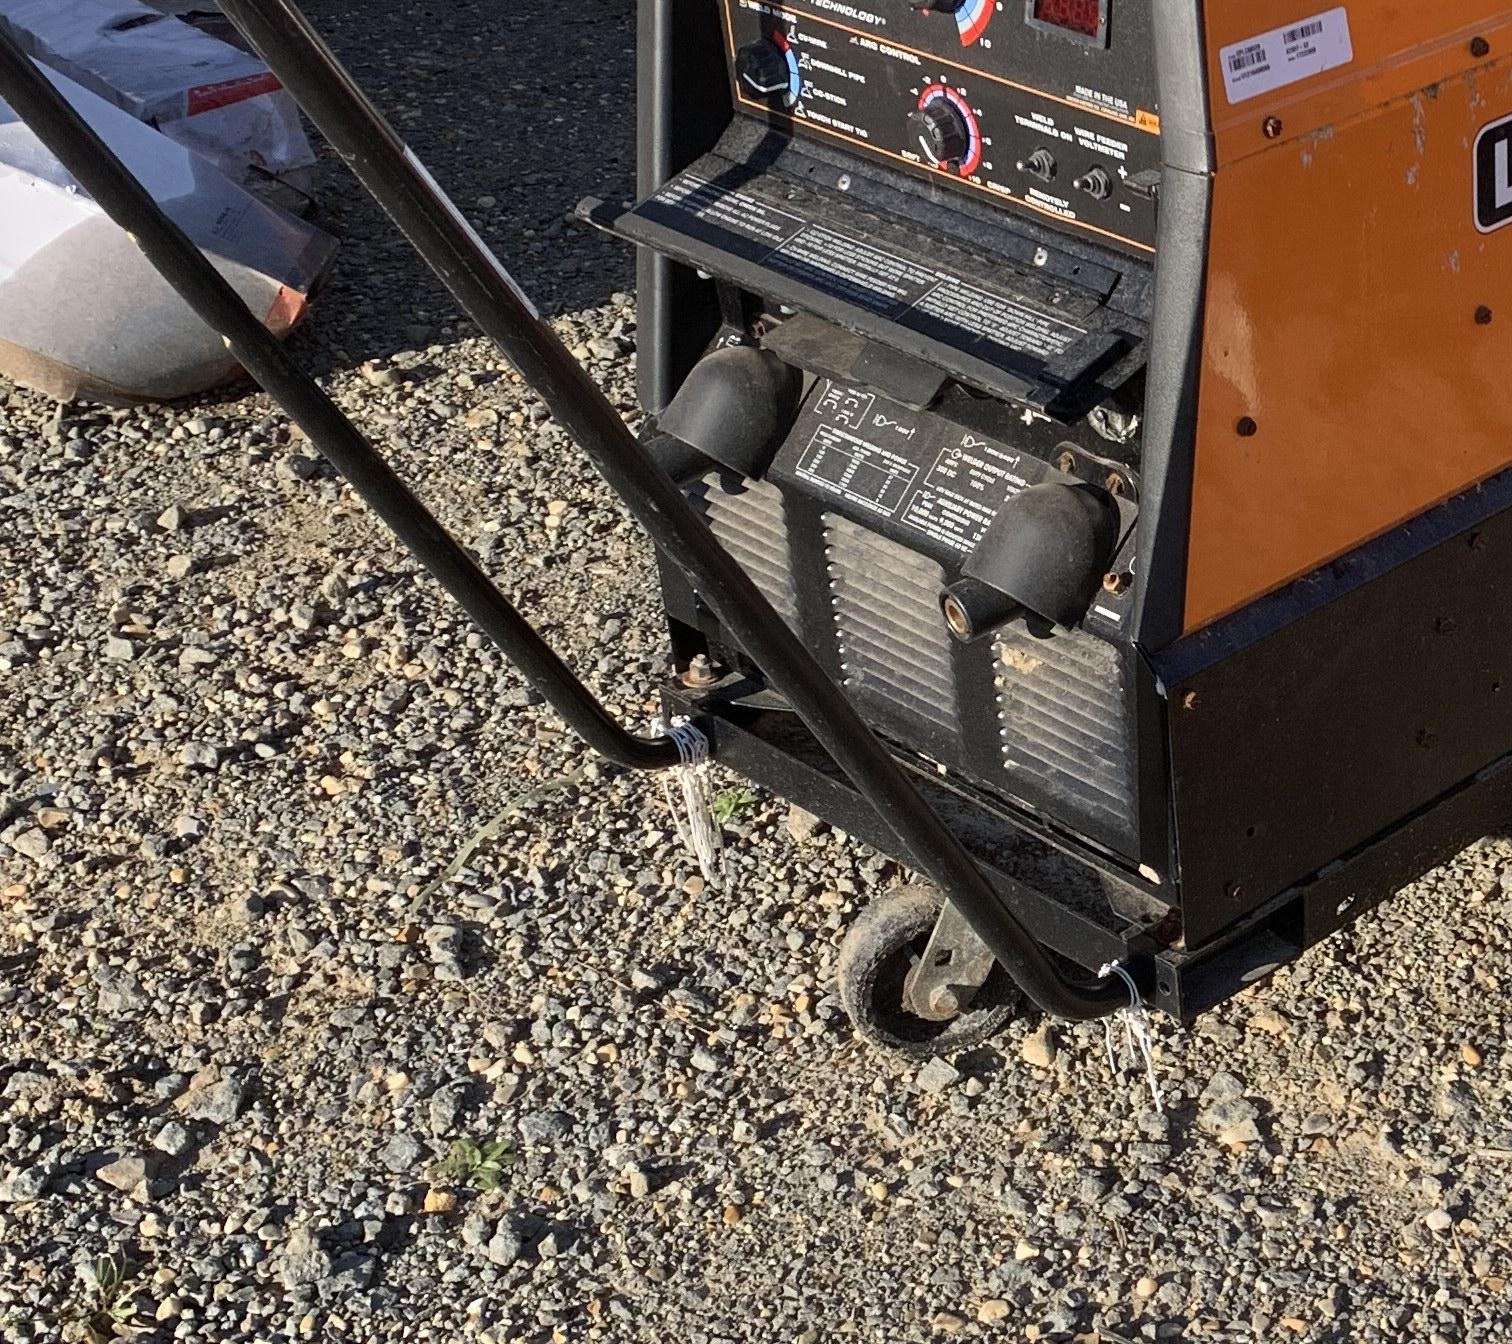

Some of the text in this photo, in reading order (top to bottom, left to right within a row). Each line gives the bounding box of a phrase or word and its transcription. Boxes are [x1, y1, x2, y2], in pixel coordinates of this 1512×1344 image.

[860, 37, 922, 65] ARC CONTROL
[980, 37, 991, 48] 10
[807, 109, 868, 138] TOUCH START TIG
[1014, 115, 1073, 142] TERMINALS ON
[1031, 112, 1054, 126] WELD
[1074, 126, 1128, 152] WIRE FEEDER
[1078, 138, 1126, 160] VOLTMETER
[1024, 194, 1076, 219] CONTROLLED
[1029, 187, 1070, 208] REMOTELY
[983, 463, 1005, 477] OUTPUT
